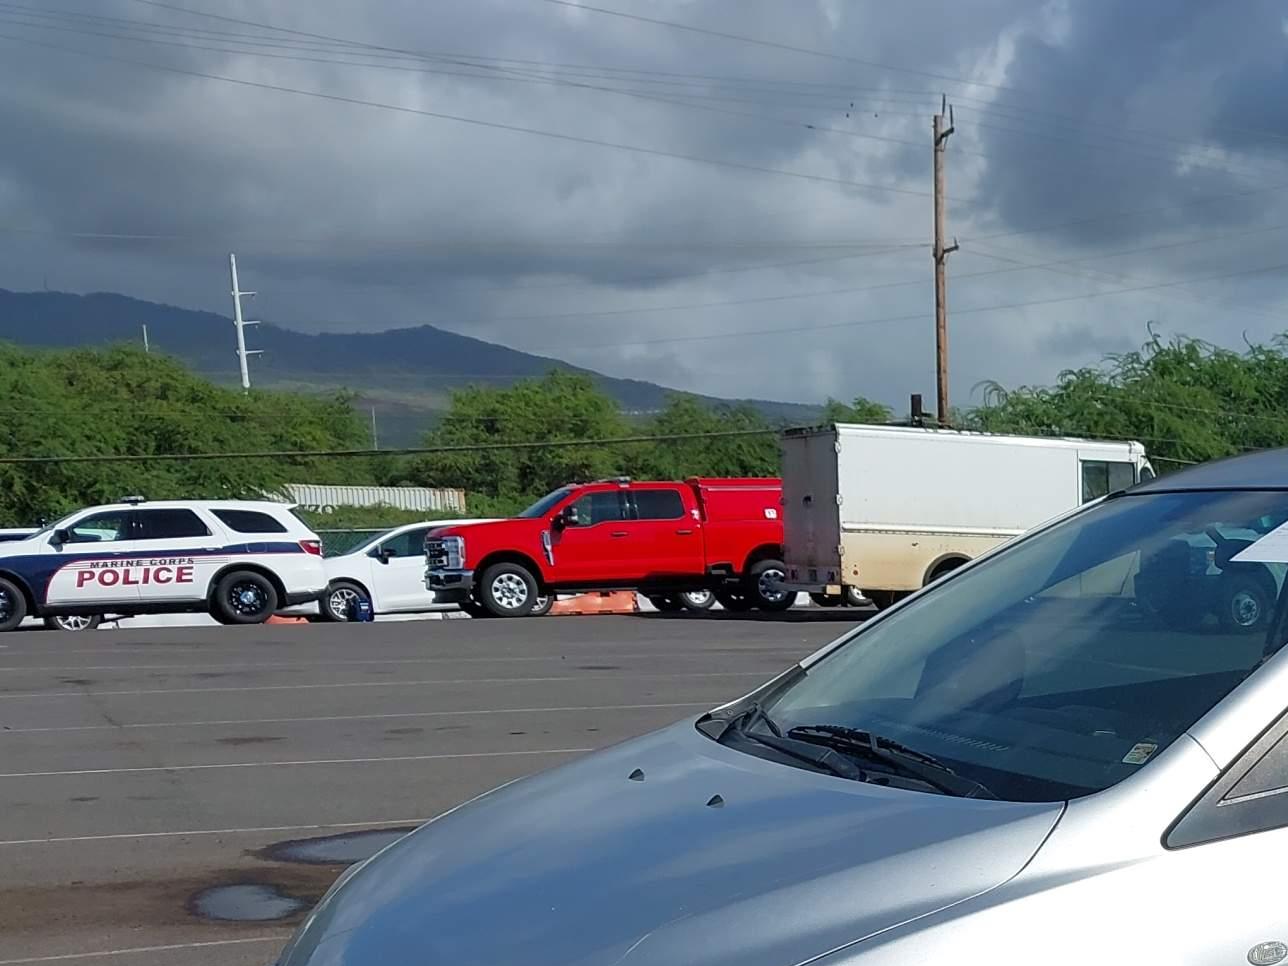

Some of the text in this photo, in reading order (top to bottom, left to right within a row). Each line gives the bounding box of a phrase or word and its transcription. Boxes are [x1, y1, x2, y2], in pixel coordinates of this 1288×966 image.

[90, 557, 194, 569] MARINE CORPS
[76, 565, 194, 589] POLICE
